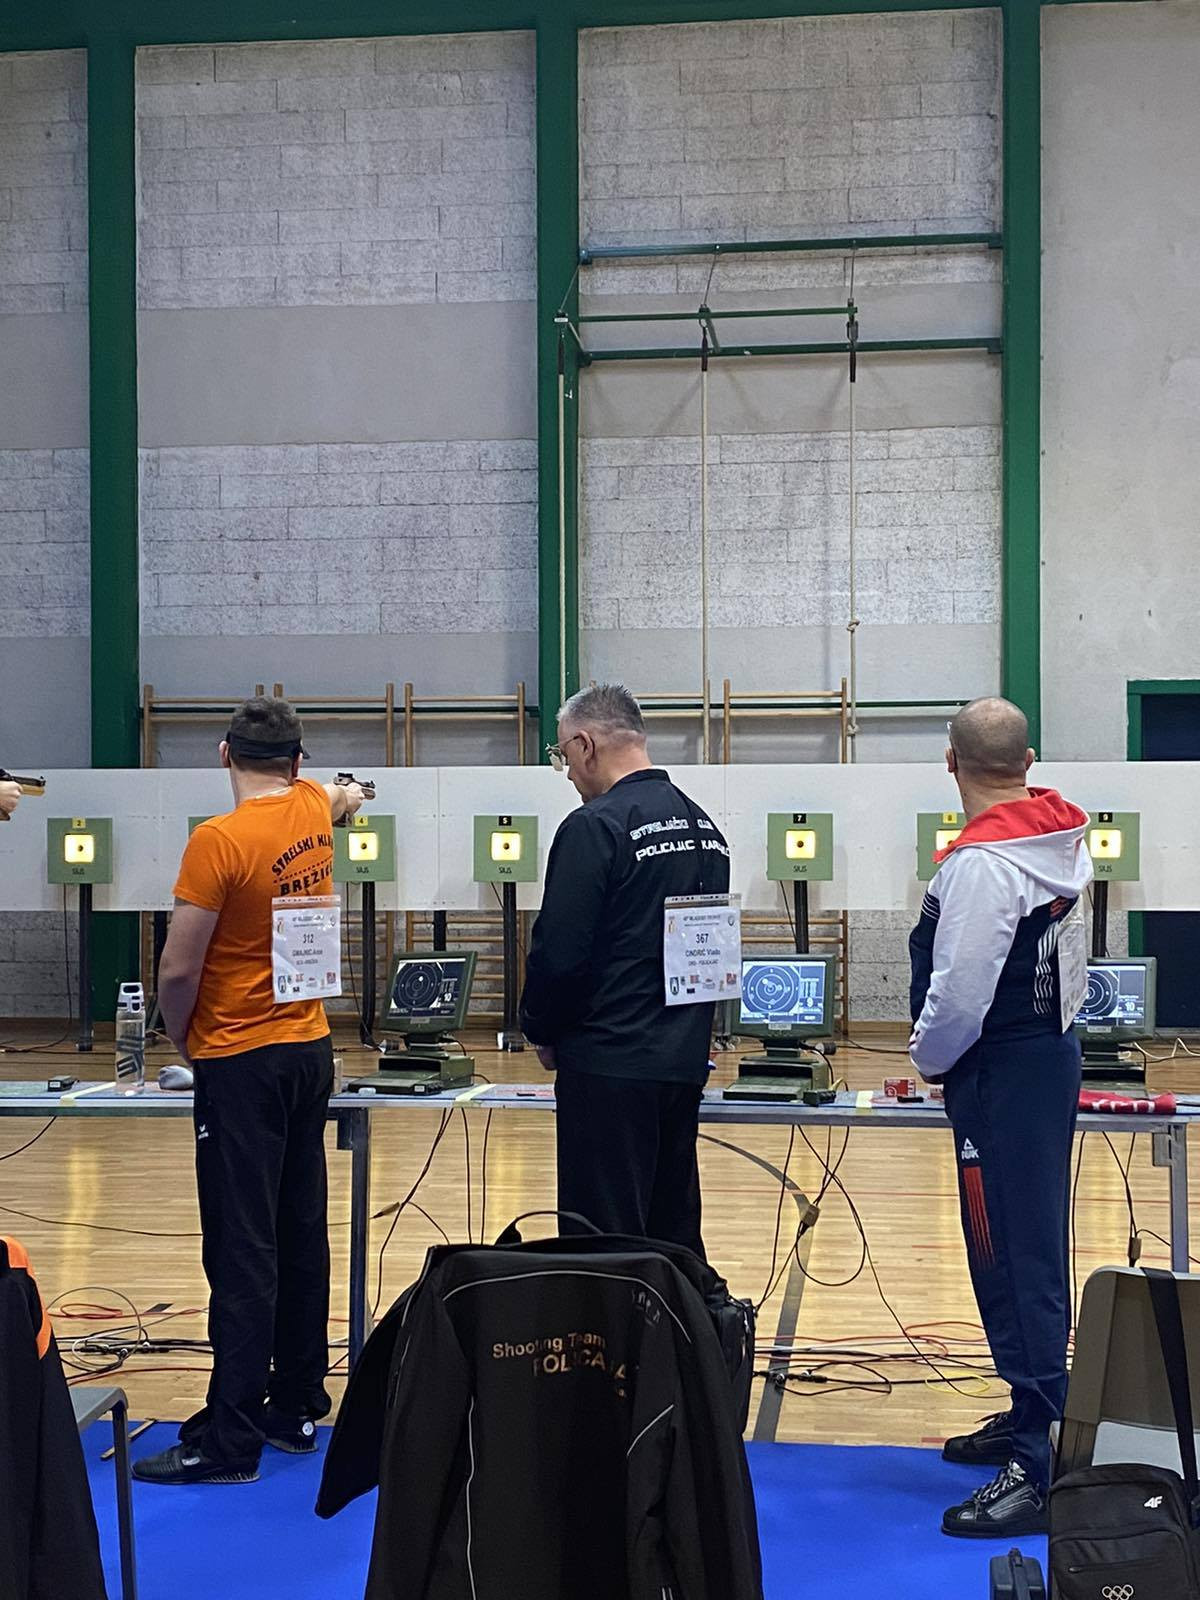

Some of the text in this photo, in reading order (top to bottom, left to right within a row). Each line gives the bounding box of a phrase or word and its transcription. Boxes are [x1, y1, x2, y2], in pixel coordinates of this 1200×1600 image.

[797, 814, 803, 822] 7
[1103, 813, 1109, 821] 9
[271, 836, 315, 877] STRELSKI
[303, 933, 314, 944] 312
[695, 933, 709, 944] 367
[444, 993, 452, 1002] 10
[806, 997, 814, 1008] 9
[1125, 1001, 1136, 1012] 10
[1143, 1495, 1163, 1509] 4F
